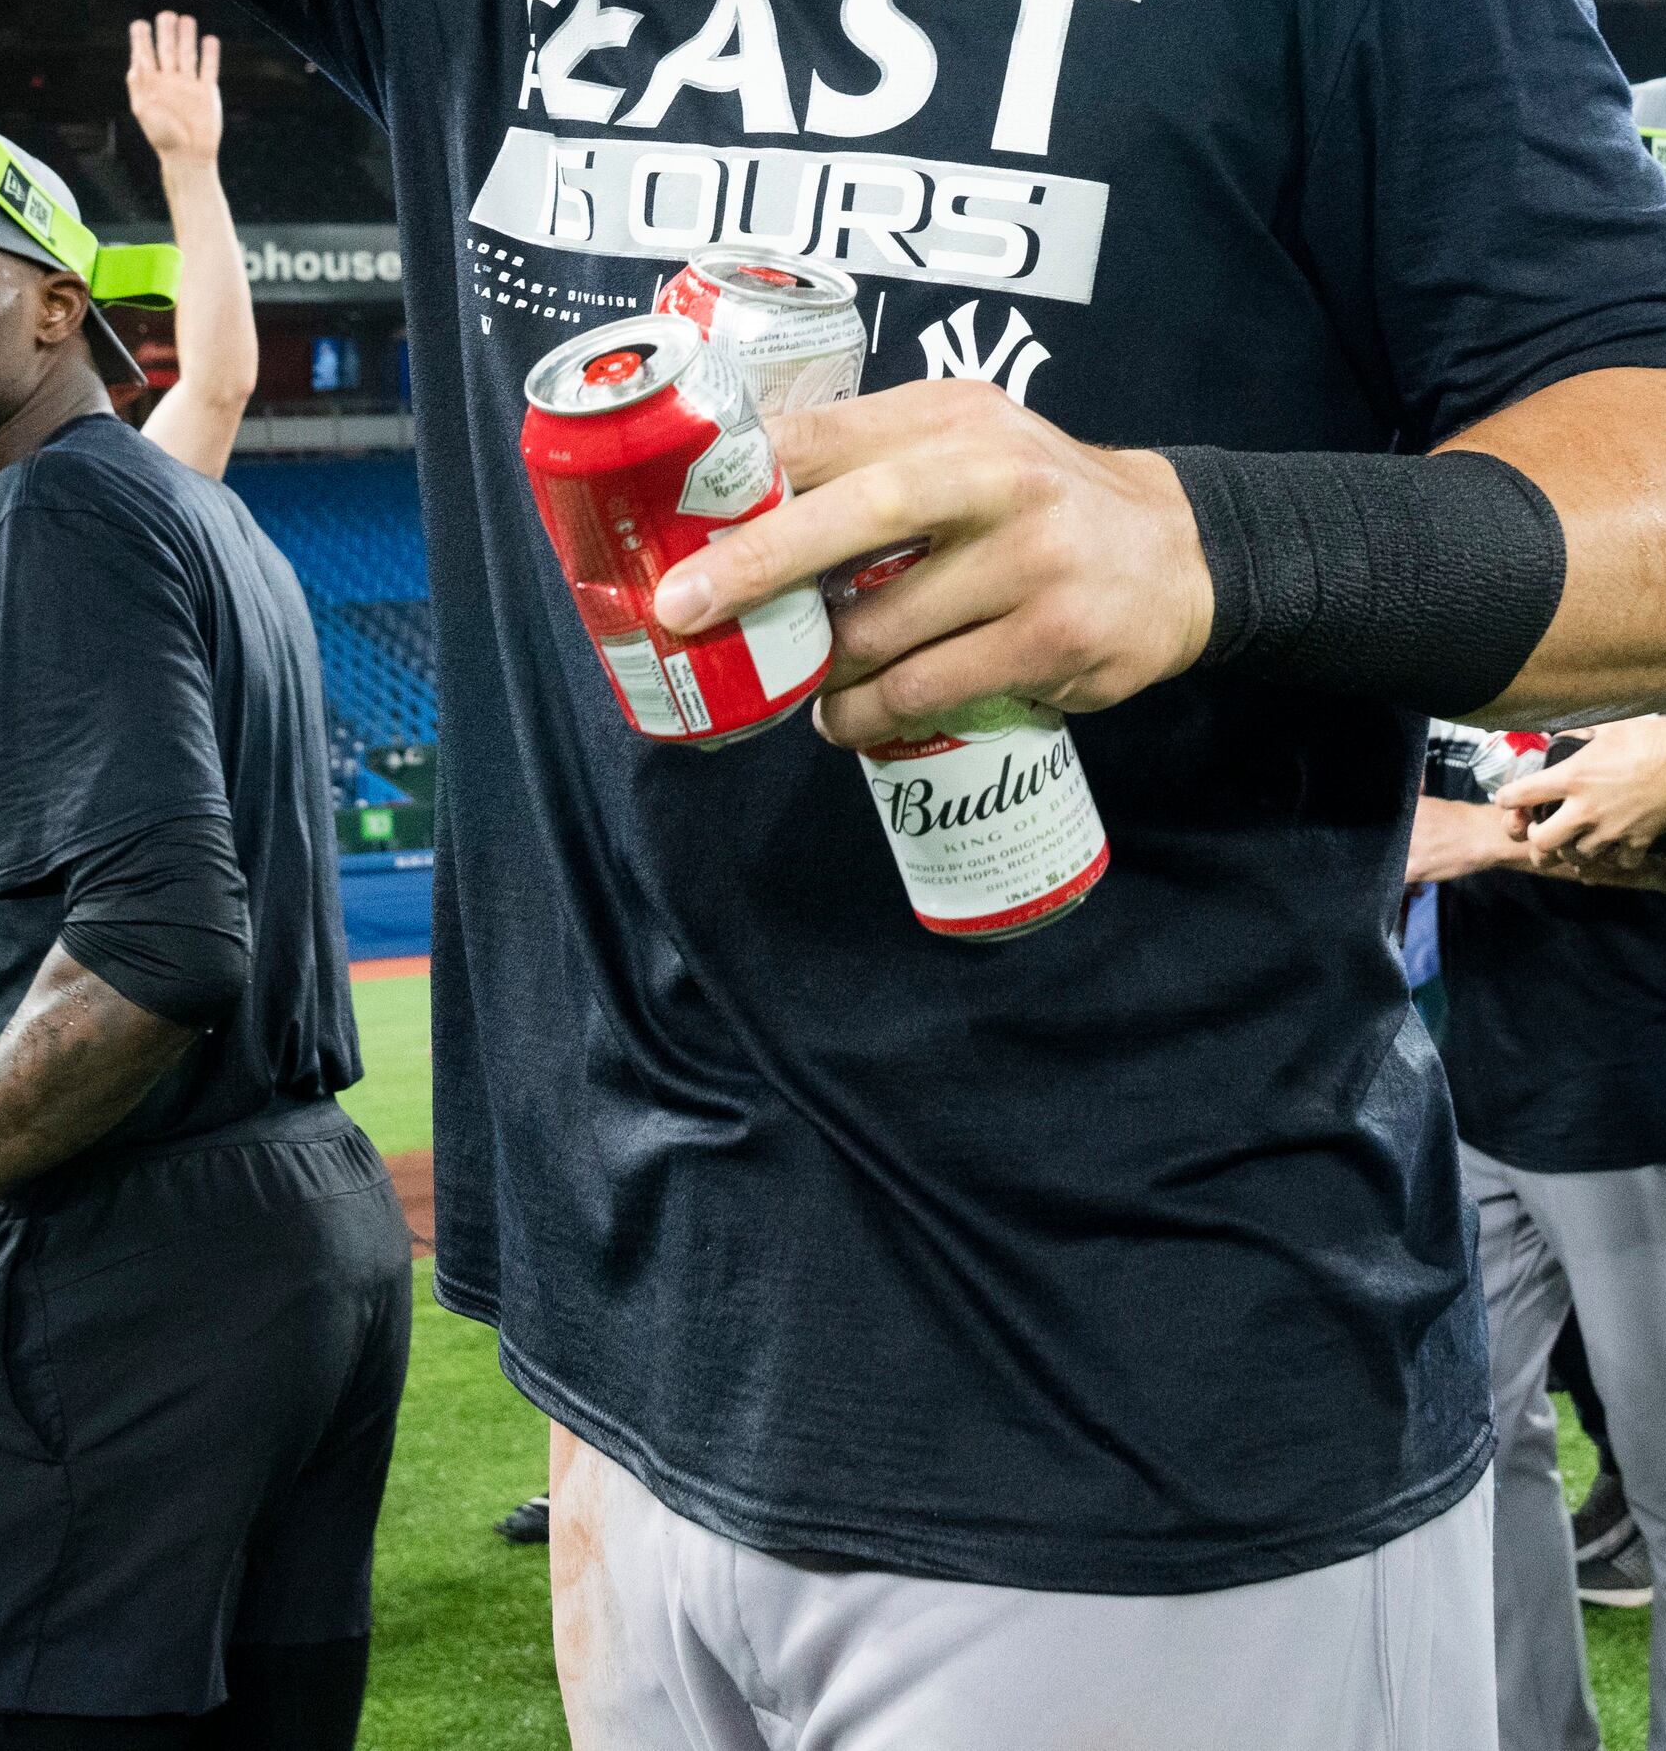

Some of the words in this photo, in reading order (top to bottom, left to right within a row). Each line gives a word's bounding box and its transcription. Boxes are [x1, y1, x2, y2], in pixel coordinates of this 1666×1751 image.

[628, 152, 1047, 279] OURS
[240, 241, 402, 282] bhouse
[474, 284, 581, 323] AMPIONS
[498, 271, 557, 297] EAST
[568, 290, 637, 308] DIVISION
[920, 740, 950, 754] MARK
[871, 734, 1075, 838] Budwei
[944, 831, 1003, 854] KING
[1014, 814, 1038, 832] OF
[967, 854, 995, 868] OUR
[999, 826, 1058, 859] ORIGINAL
[1007, 852, 1037, 869] RICE
[1041, 835, 1064, 854] AND
